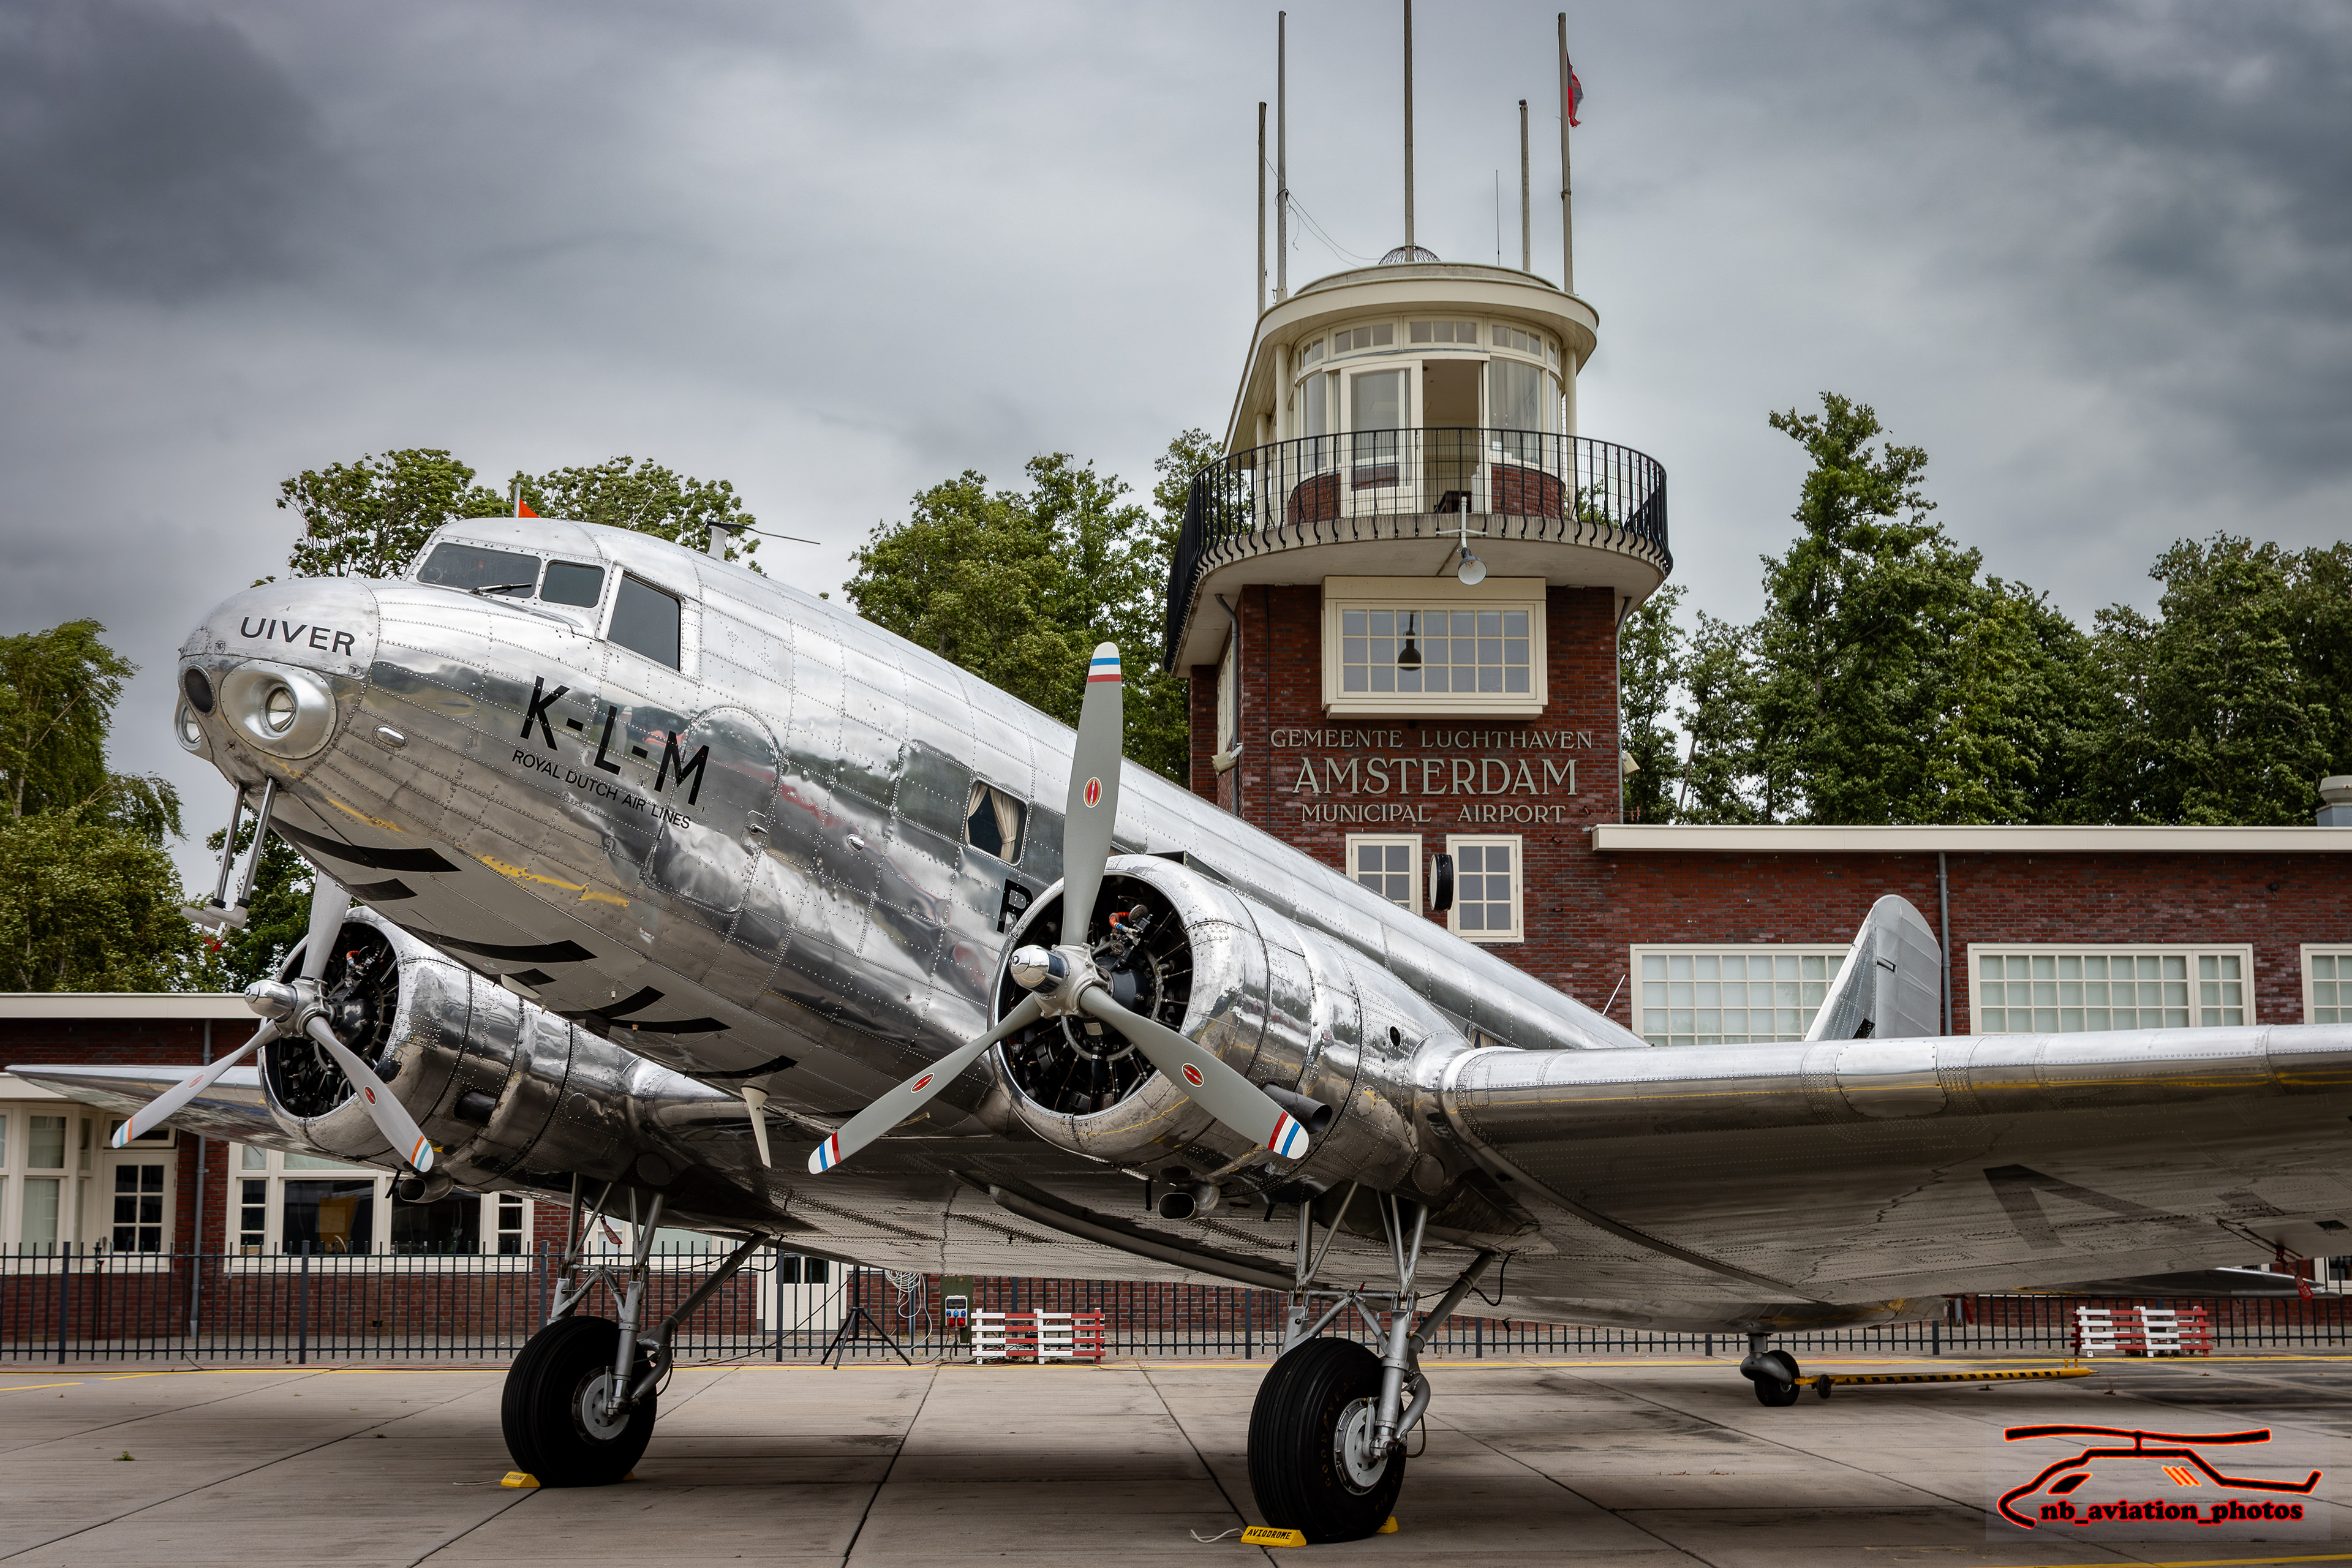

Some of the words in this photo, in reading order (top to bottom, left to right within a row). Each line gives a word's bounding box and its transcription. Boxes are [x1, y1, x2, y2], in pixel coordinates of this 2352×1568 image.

[241, 617, 355, 657] UIVER
[520, 676, 710, 806] K-L-M
[1270, 729, 1403, 748] GEMEENTE
[1420, 730, 1593, 749] LUCHTHAVEN
[511, 749, 560, 779] ROYAL
[565, 770, 618, 801] DUTCH
[622, 794, 646, 812] AIR
[650, 804, 691, 829] LINES
[1292, 756, 1578, 796] AMSTERDAM
[1301, 804, 1432, 823] MUNICIPAL
[1457, 804, 1566, 824] AIRPORT
[1246, 1528, 1292, 1540] AVIODROME
